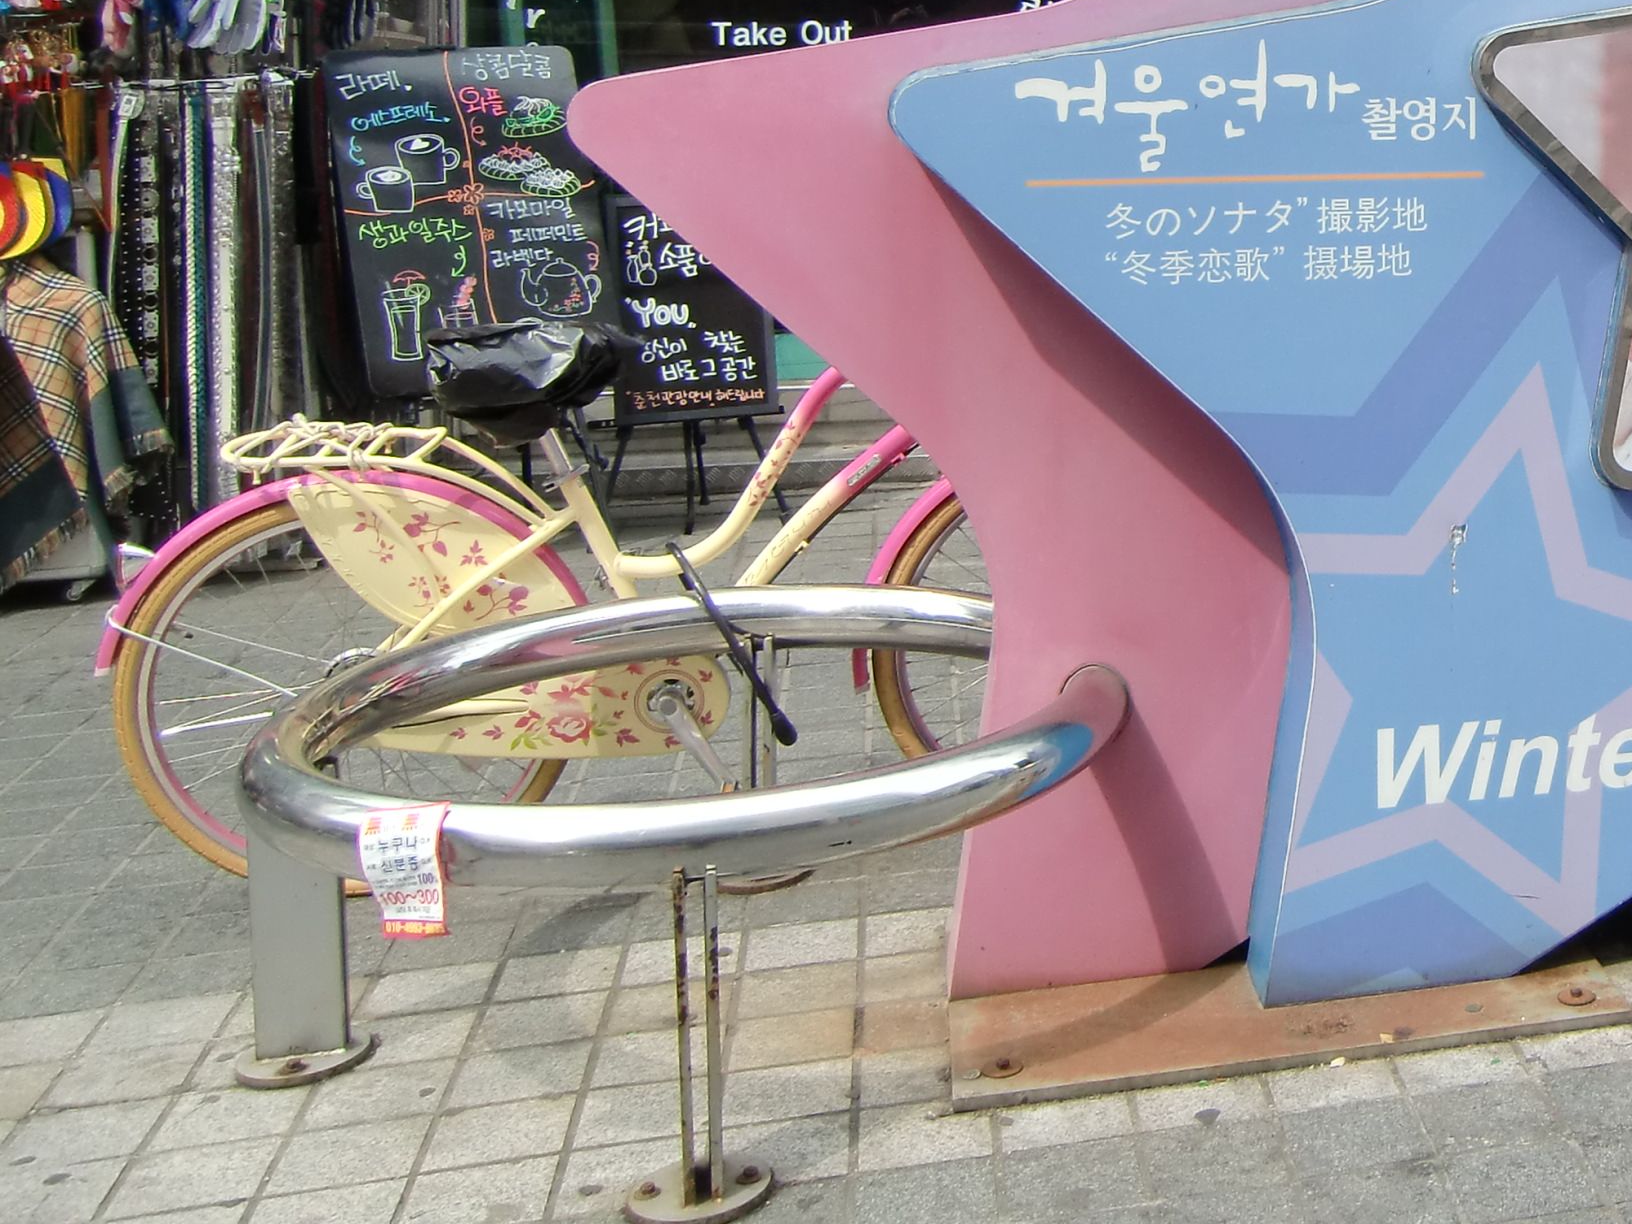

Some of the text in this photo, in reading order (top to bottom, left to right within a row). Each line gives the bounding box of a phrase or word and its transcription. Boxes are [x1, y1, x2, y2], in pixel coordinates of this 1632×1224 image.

[711, 20, 853, 46] Take Out
[459, 86, 508, 117] 와플
[1014, 38, 1478, 172] 겨울연가 촬영지
[486, 197, 576, 220] 카모마일
[1317, 196, 1429, 234] 撮影地
[359, 217, 473, 249] 생과일주스
[509, 223, 588, 243] 페퍼민트
[490, 247, 554, 268] 라벤다
[703, 330, 747, 354] 찾는
[660, 355, 758, 382] 바로 그 공간
